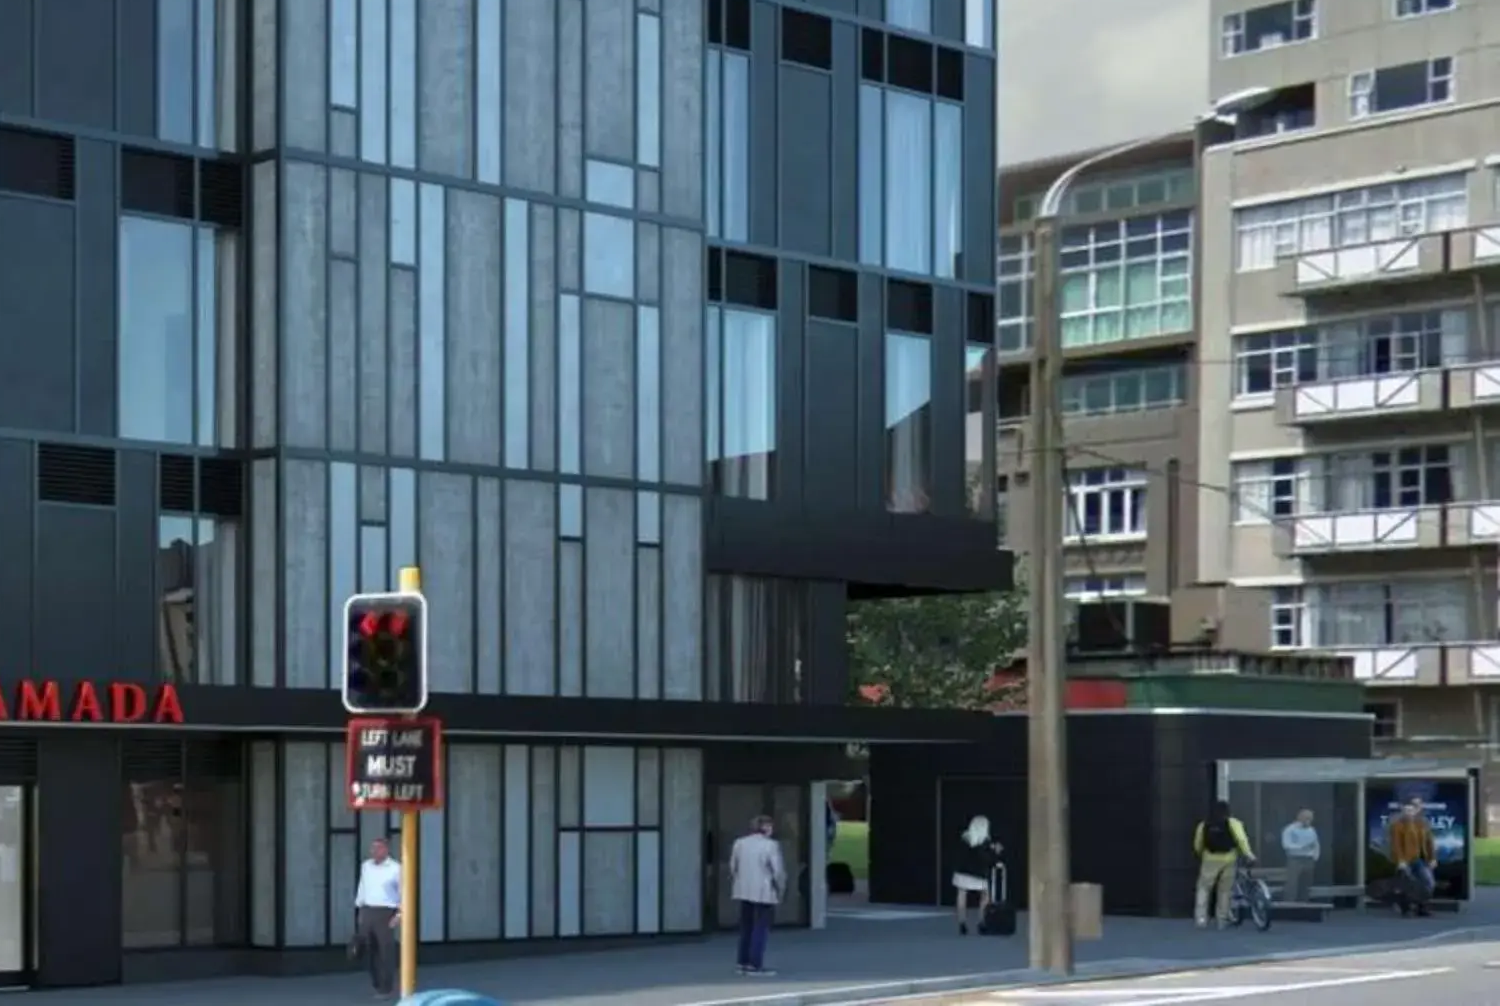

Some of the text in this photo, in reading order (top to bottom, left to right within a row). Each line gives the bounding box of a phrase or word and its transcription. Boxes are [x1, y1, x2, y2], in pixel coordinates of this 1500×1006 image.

[361, 729, 388, 746] LEFT
[367, 755, 417, 777] MUST
[394, 783, 424, 801] LEFT
